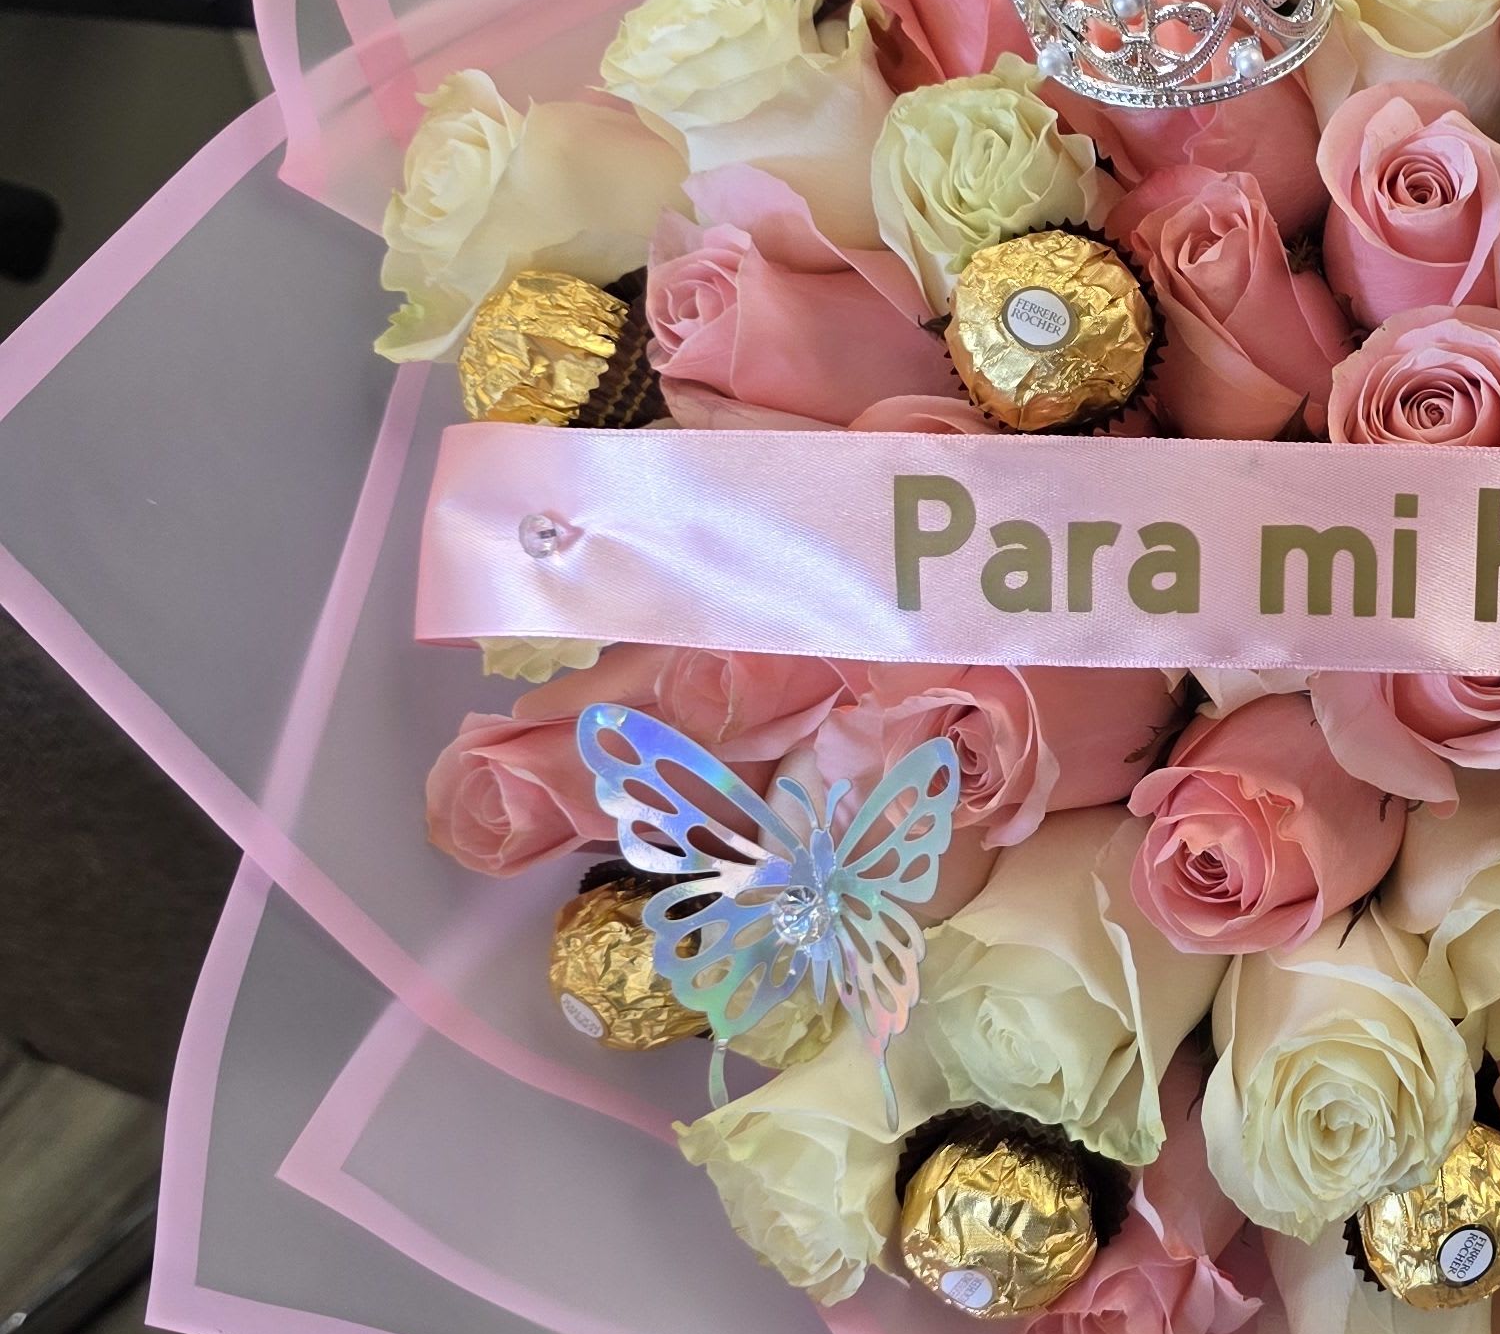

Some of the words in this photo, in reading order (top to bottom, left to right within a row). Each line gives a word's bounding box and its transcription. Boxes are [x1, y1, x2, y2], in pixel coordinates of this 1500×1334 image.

[1011, 308, 1061, 336] ROCHER
[1015, 298, 1067, 326] FERRERO
[894, 475, 1201, 615] Para
[1260, 493, 1419, 620] mi
[1447, 1232, 1478, 1274] ROCHER
[1456, 1236, 1487, 1279] FERRERO
